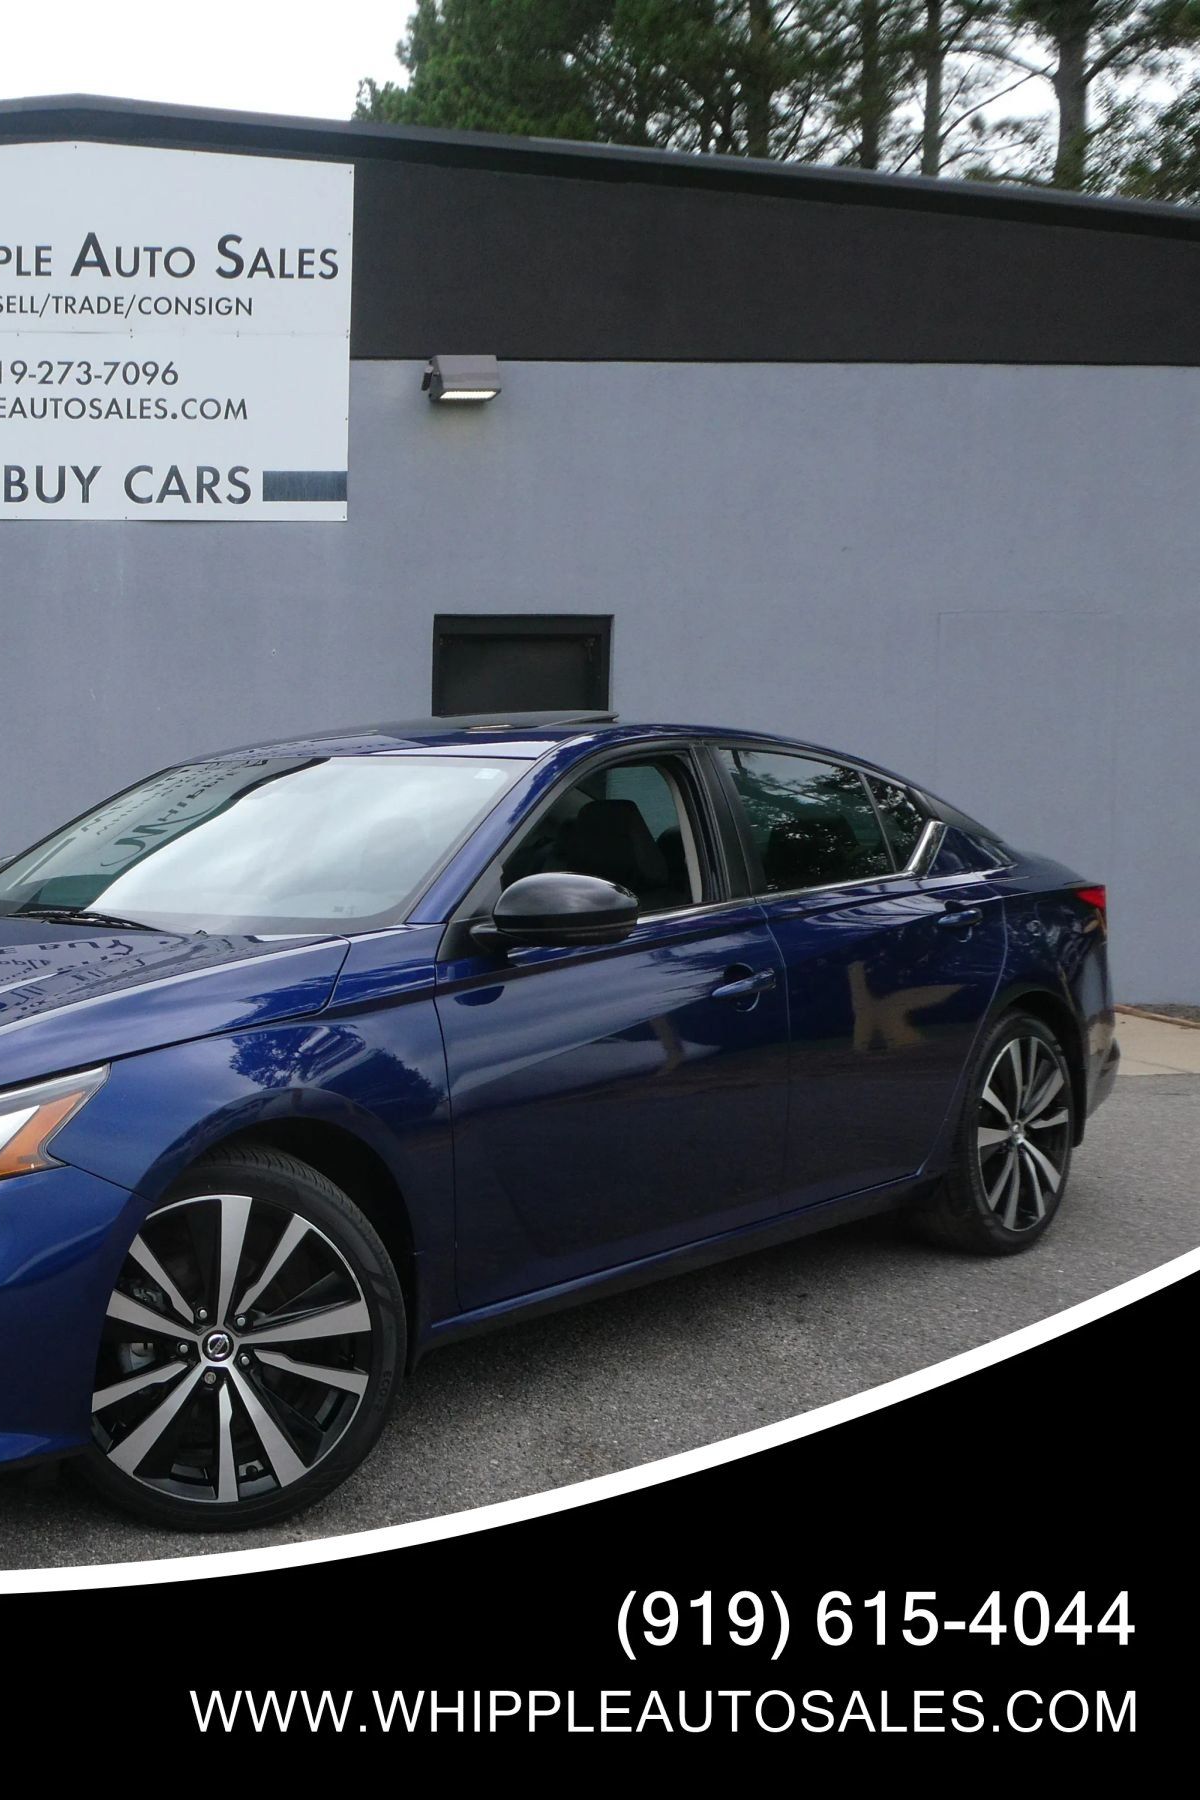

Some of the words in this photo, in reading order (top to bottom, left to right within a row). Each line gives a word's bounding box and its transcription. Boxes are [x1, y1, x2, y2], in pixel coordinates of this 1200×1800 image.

[70, 231, 196, 279] AUTO
[215, 233, 339, 280] SALES
[3, 464, 102, 504] BUY
[123, 464, 252, 505] CARS
